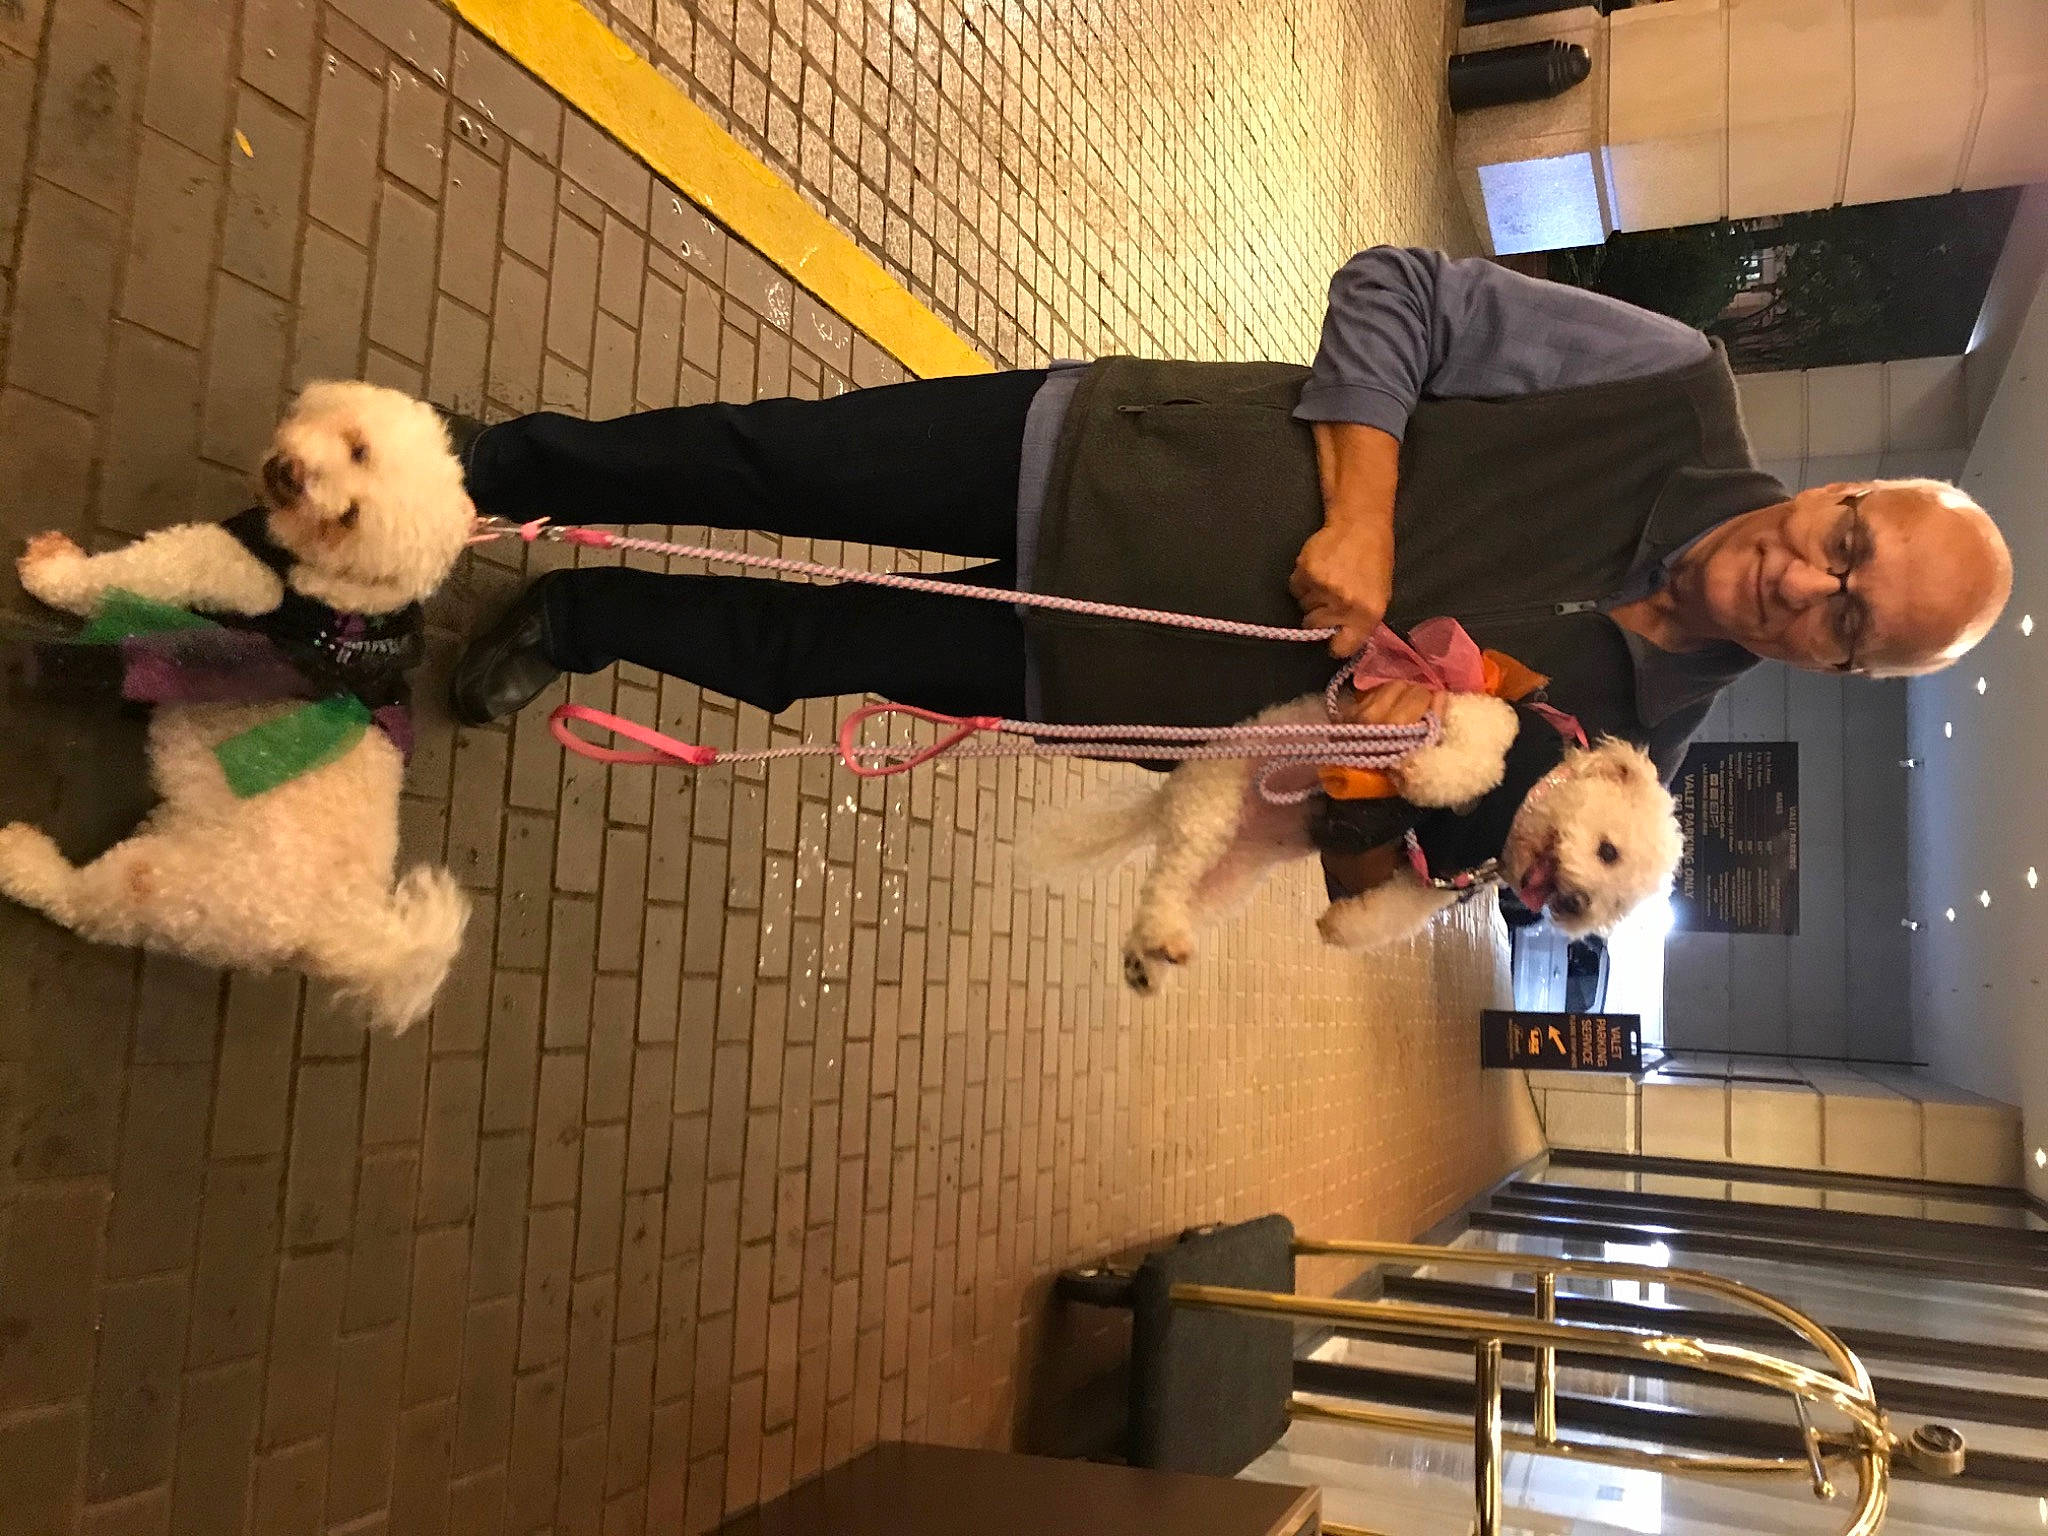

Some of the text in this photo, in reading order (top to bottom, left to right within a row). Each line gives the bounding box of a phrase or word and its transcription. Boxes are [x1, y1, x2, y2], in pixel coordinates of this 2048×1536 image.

[1776, 792, 1784, 814] RATES
[1684, 774, 1694, 899] VALET PARKING ONLY
[1582, 1020, 1593, 1065] SERVICE
[1596, 1018, 1608, 1066] PARKING
[1610, 1026, 1622, 1059] VALET
